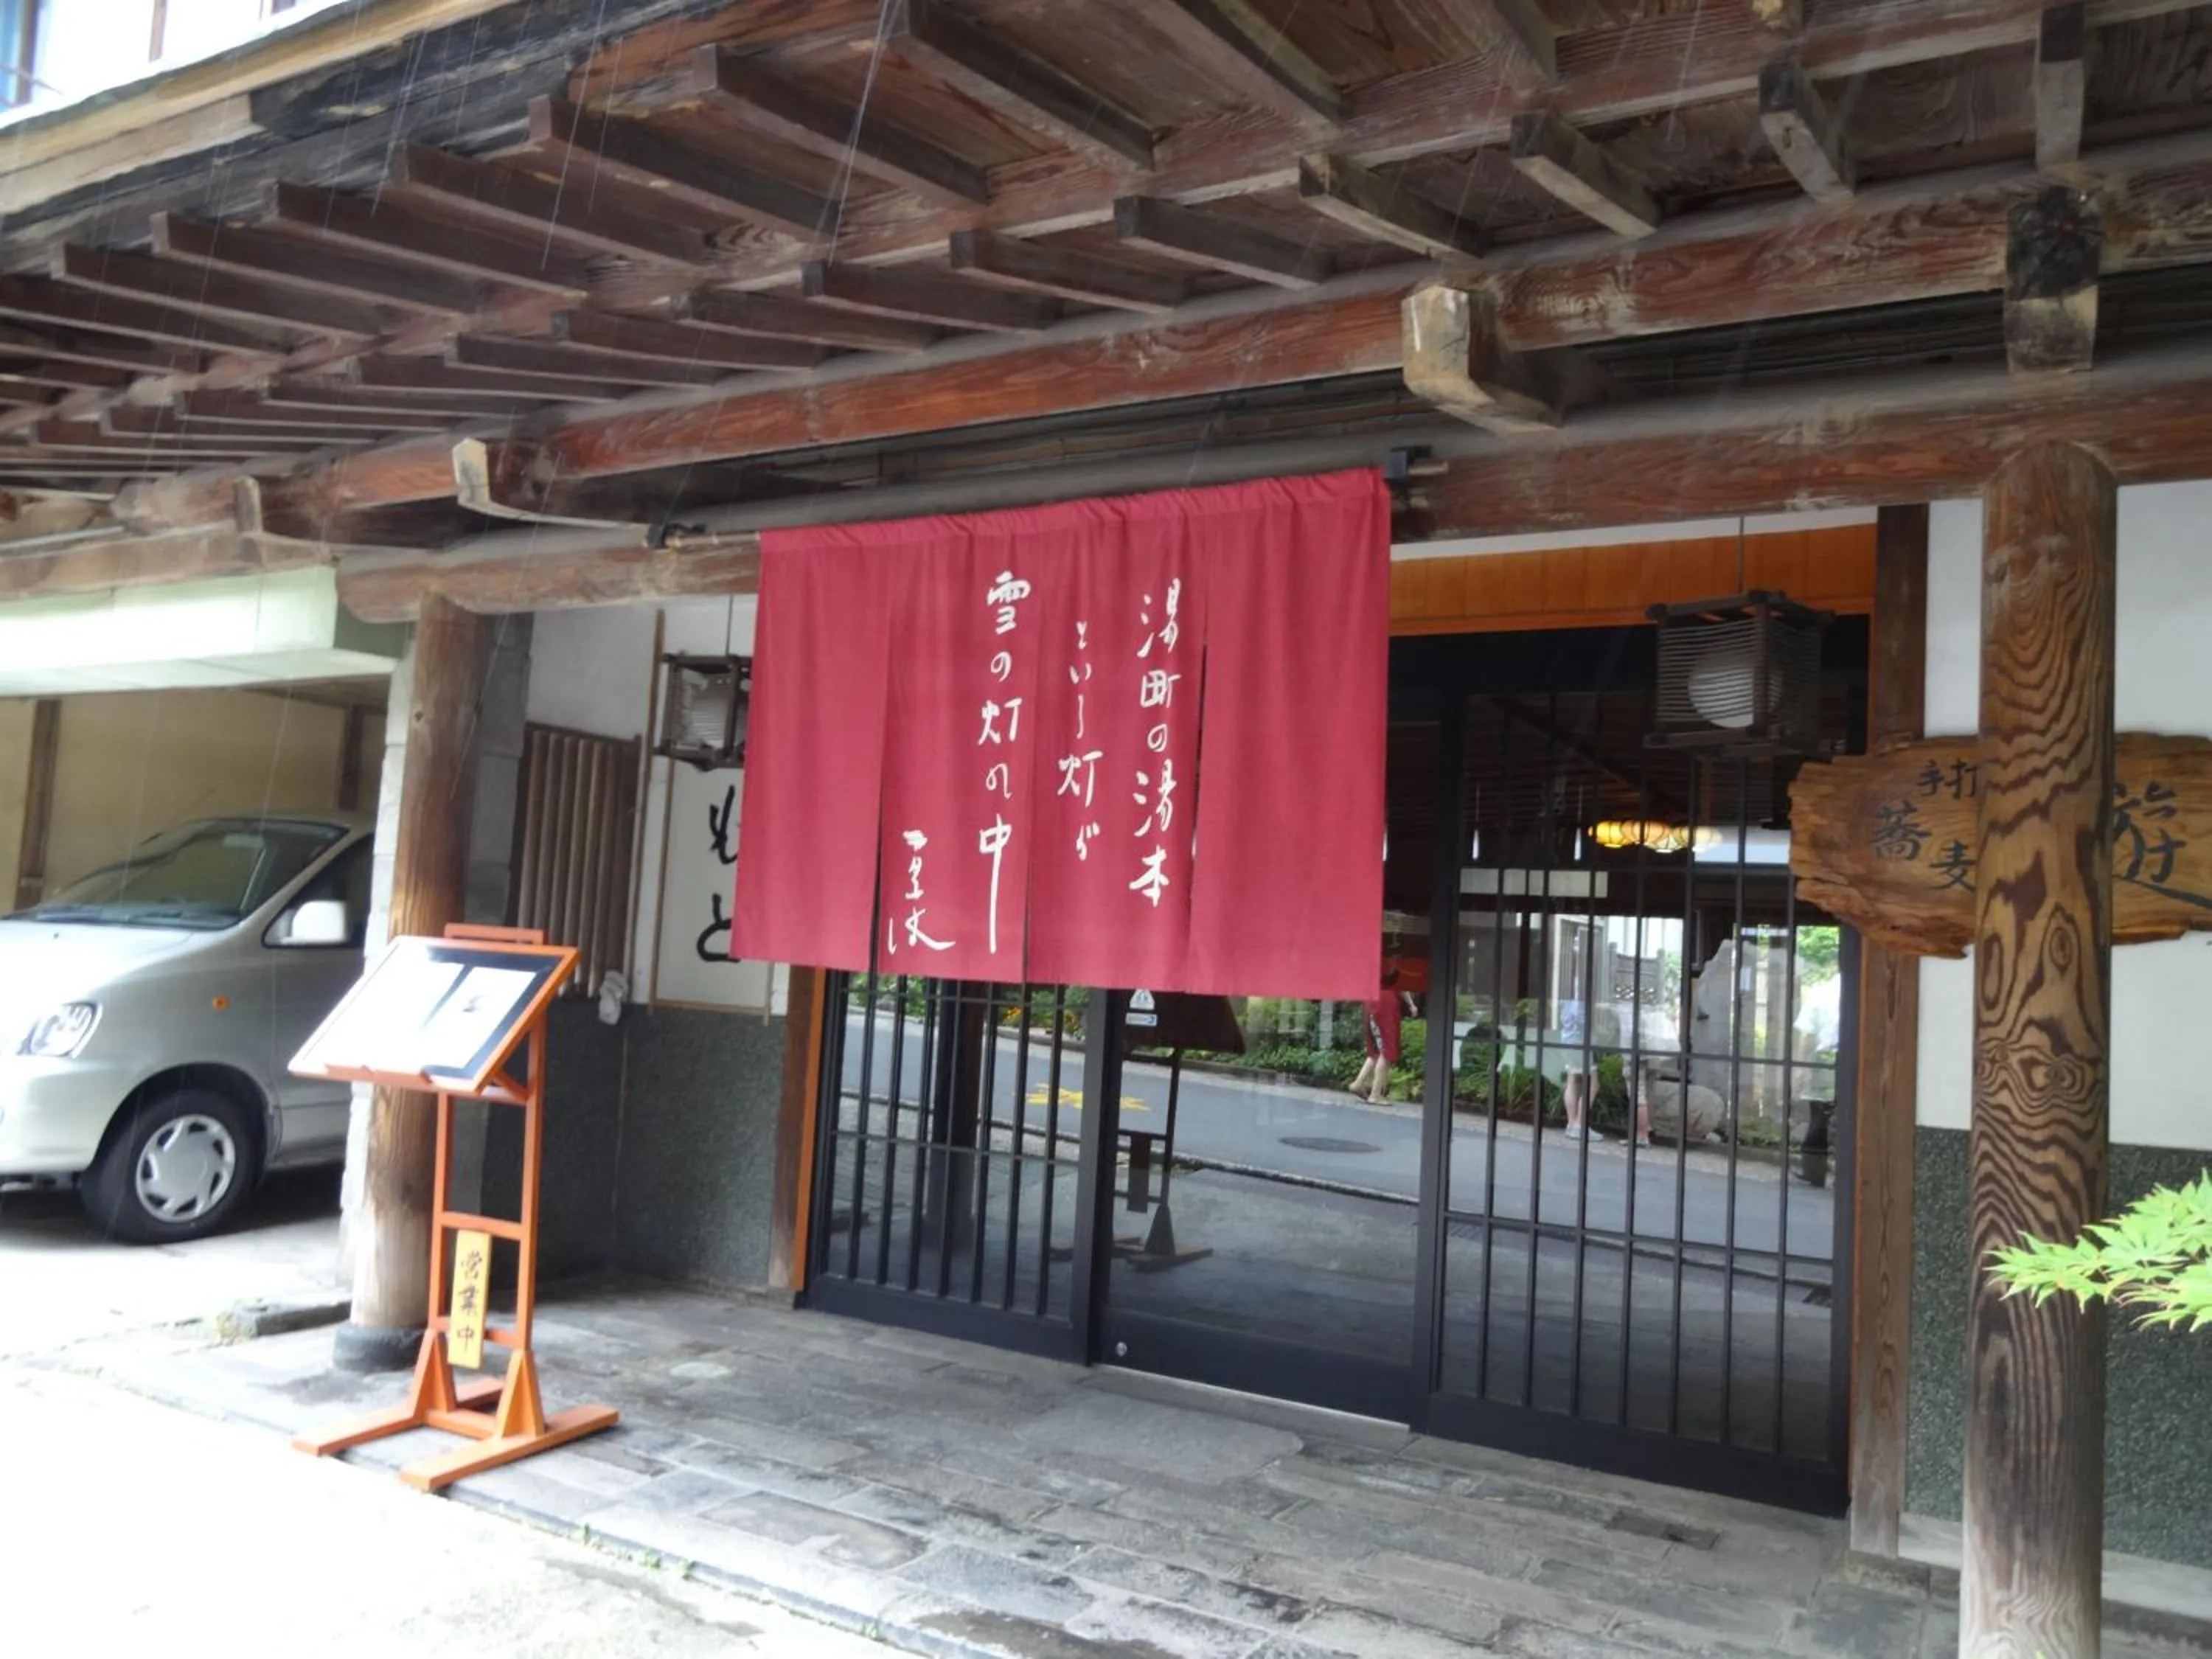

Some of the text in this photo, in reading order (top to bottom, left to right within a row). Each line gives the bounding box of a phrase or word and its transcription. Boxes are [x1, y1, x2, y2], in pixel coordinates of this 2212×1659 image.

[977, 570, 1032, 956] 雪の灯の中
[1128, 577, 1181, 908] 湯町の湯本
[458, 1251, 483, 1351] 営業中
